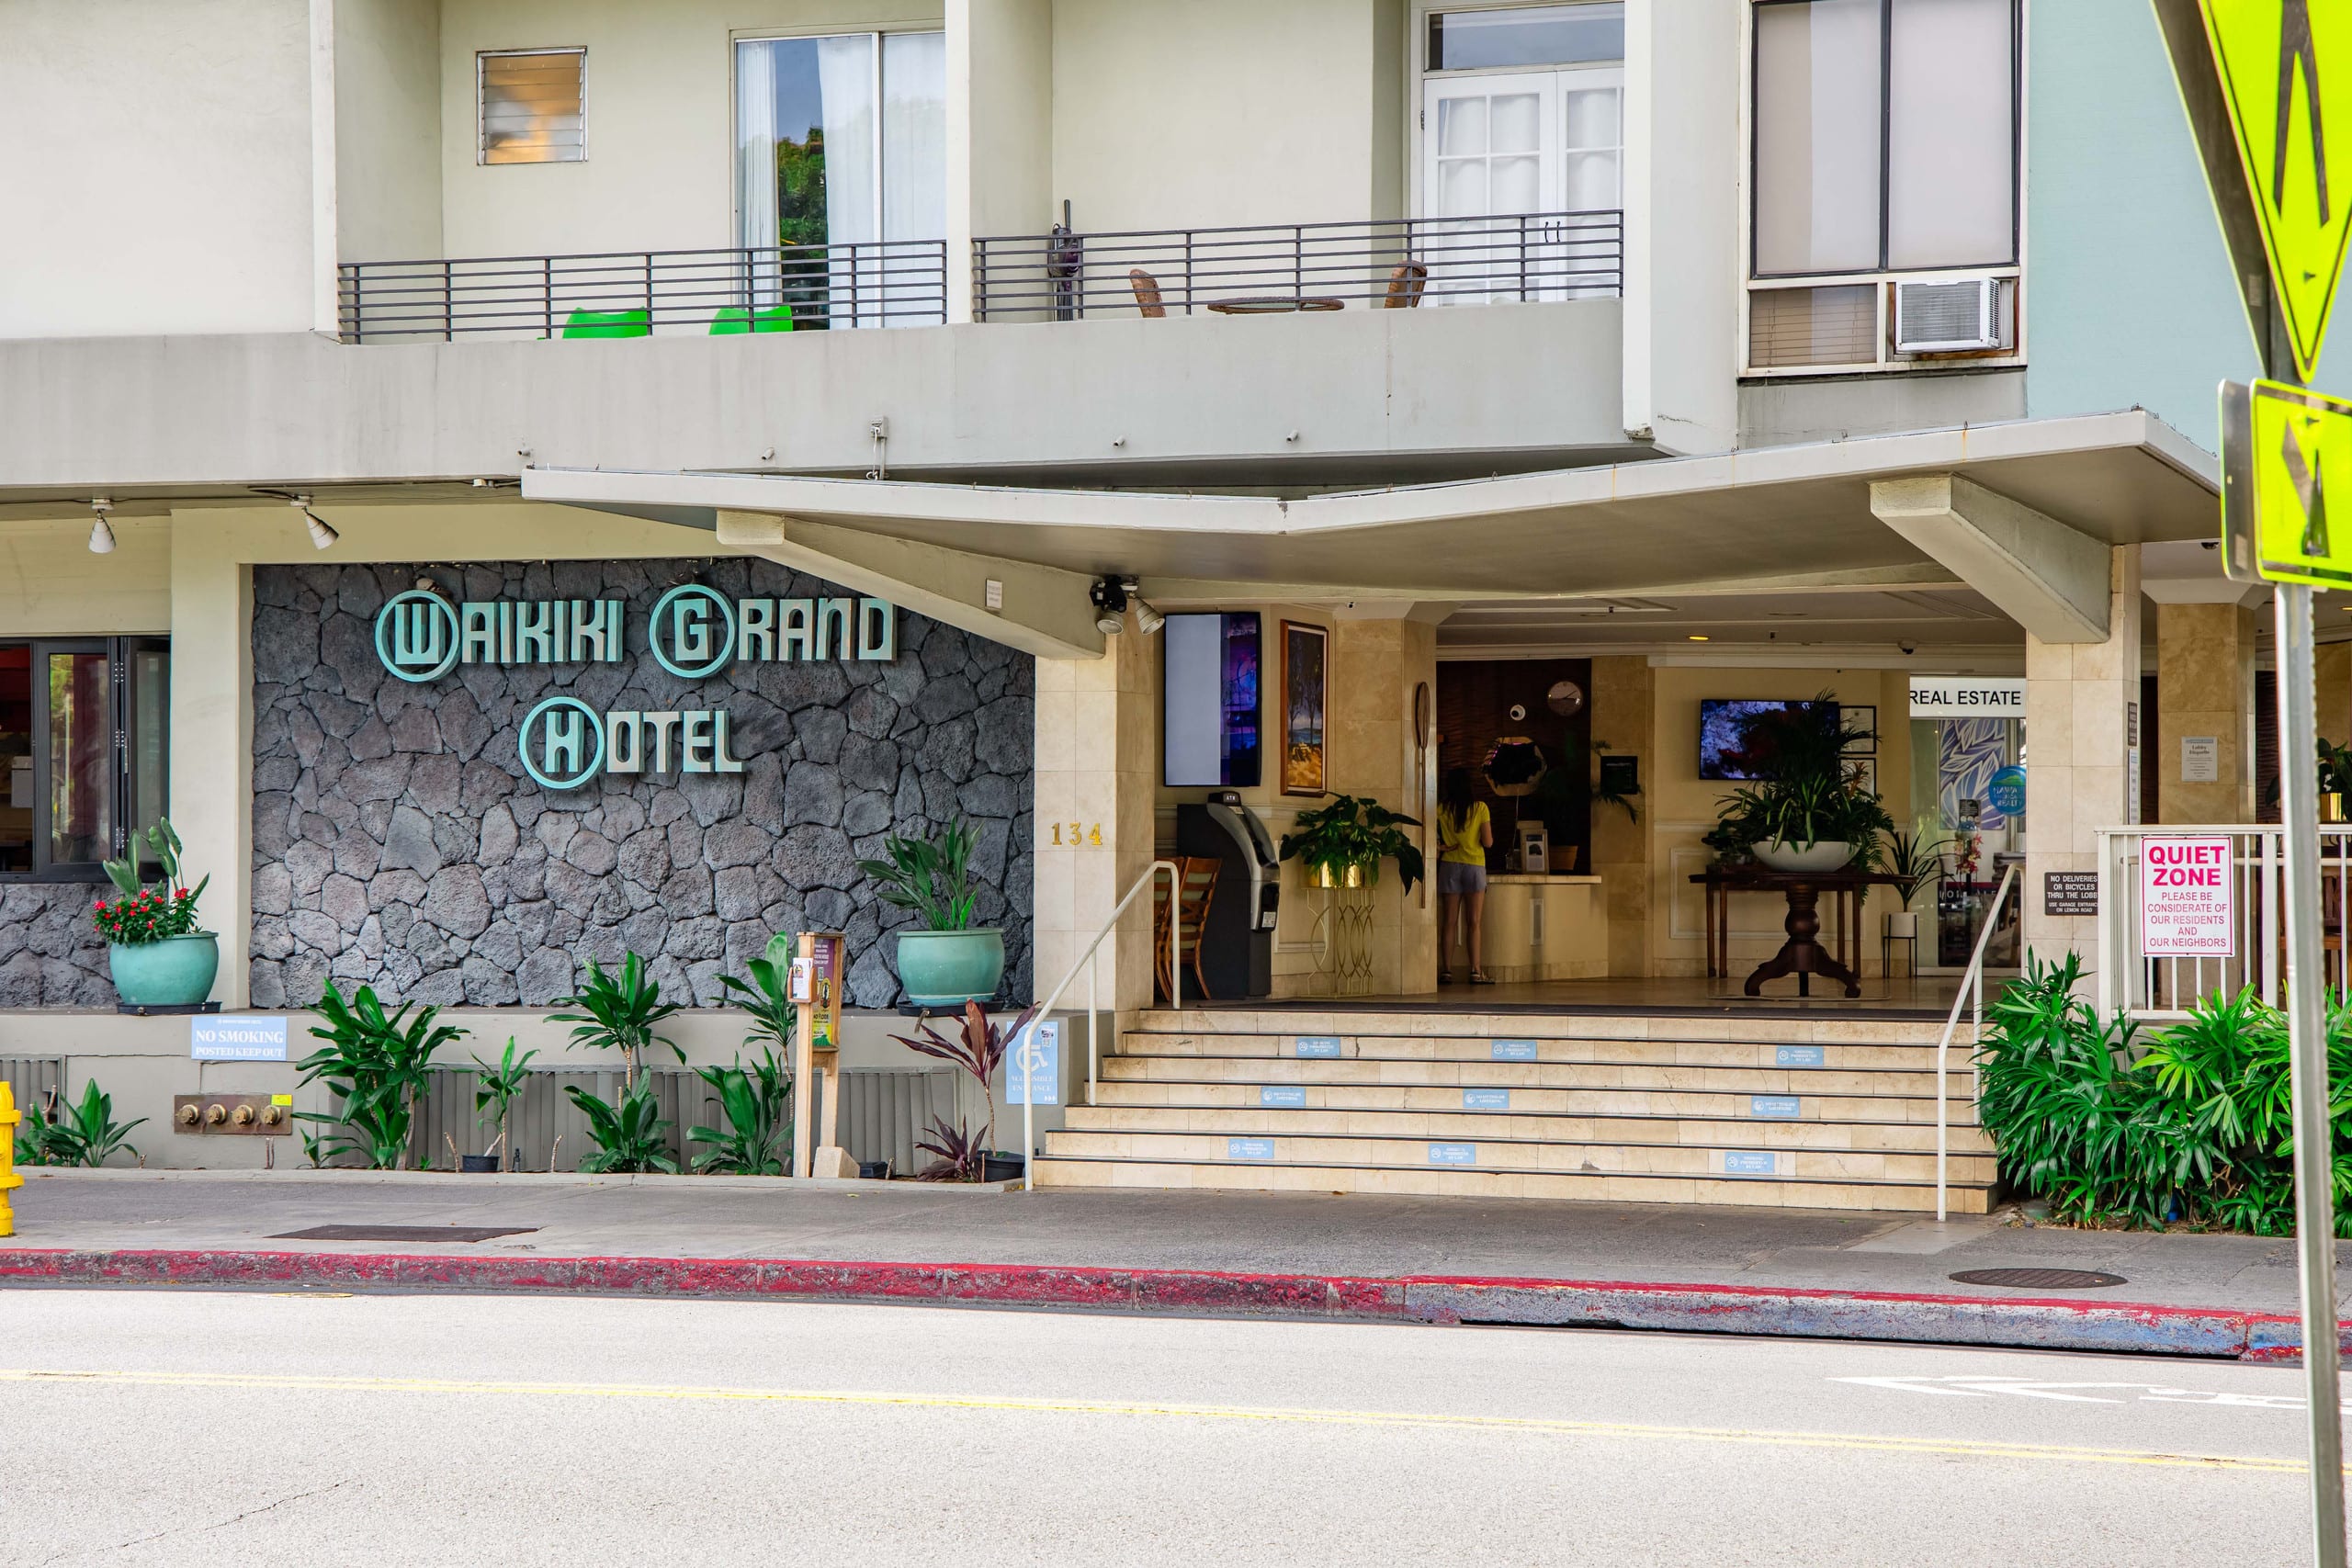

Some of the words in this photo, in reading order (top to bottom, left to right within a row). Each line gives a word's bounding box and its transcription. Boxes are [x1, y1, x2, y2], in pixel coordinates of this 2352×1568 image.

[392, 600, 624, 664] WAIKIKI
[672, 597, 899, 661] GRAND
[1910, 690, 1952, 705] REAL
[1957, 690, 2021, 705] ESTATE
[544, 710, 743, 773] HOTEL
[1051, 822, 1103, 846] 134
[2149, 846, 2225, 865] QUIET
[2153, 868, 2222, 886] ZONE
[2162, 892, 2197, 900] PLEASE
[2200, 892, 2212, 900] BE
[2148, 904, 2211, 912] CONSIDERATE
[2215, 904, 2227, 912] OF
[2151, 916, 2170, 924] OUR
[2173, 916, 2224, 924] RESIDENTS
[2178, 927, 2197, 935] AND
[2150, 938, 2169, 946] OUR
[2172, 938, 2226, 947] NEIGHBORS
[196, 1030, 216, 1042] NO
[219, 1031, 284, 1043] SMOKING
[196, 1046, 233, 1055] POSTED
[235, 1047, 262, 1056] KEEP
[263, 1048, 283, 1057] OUT
